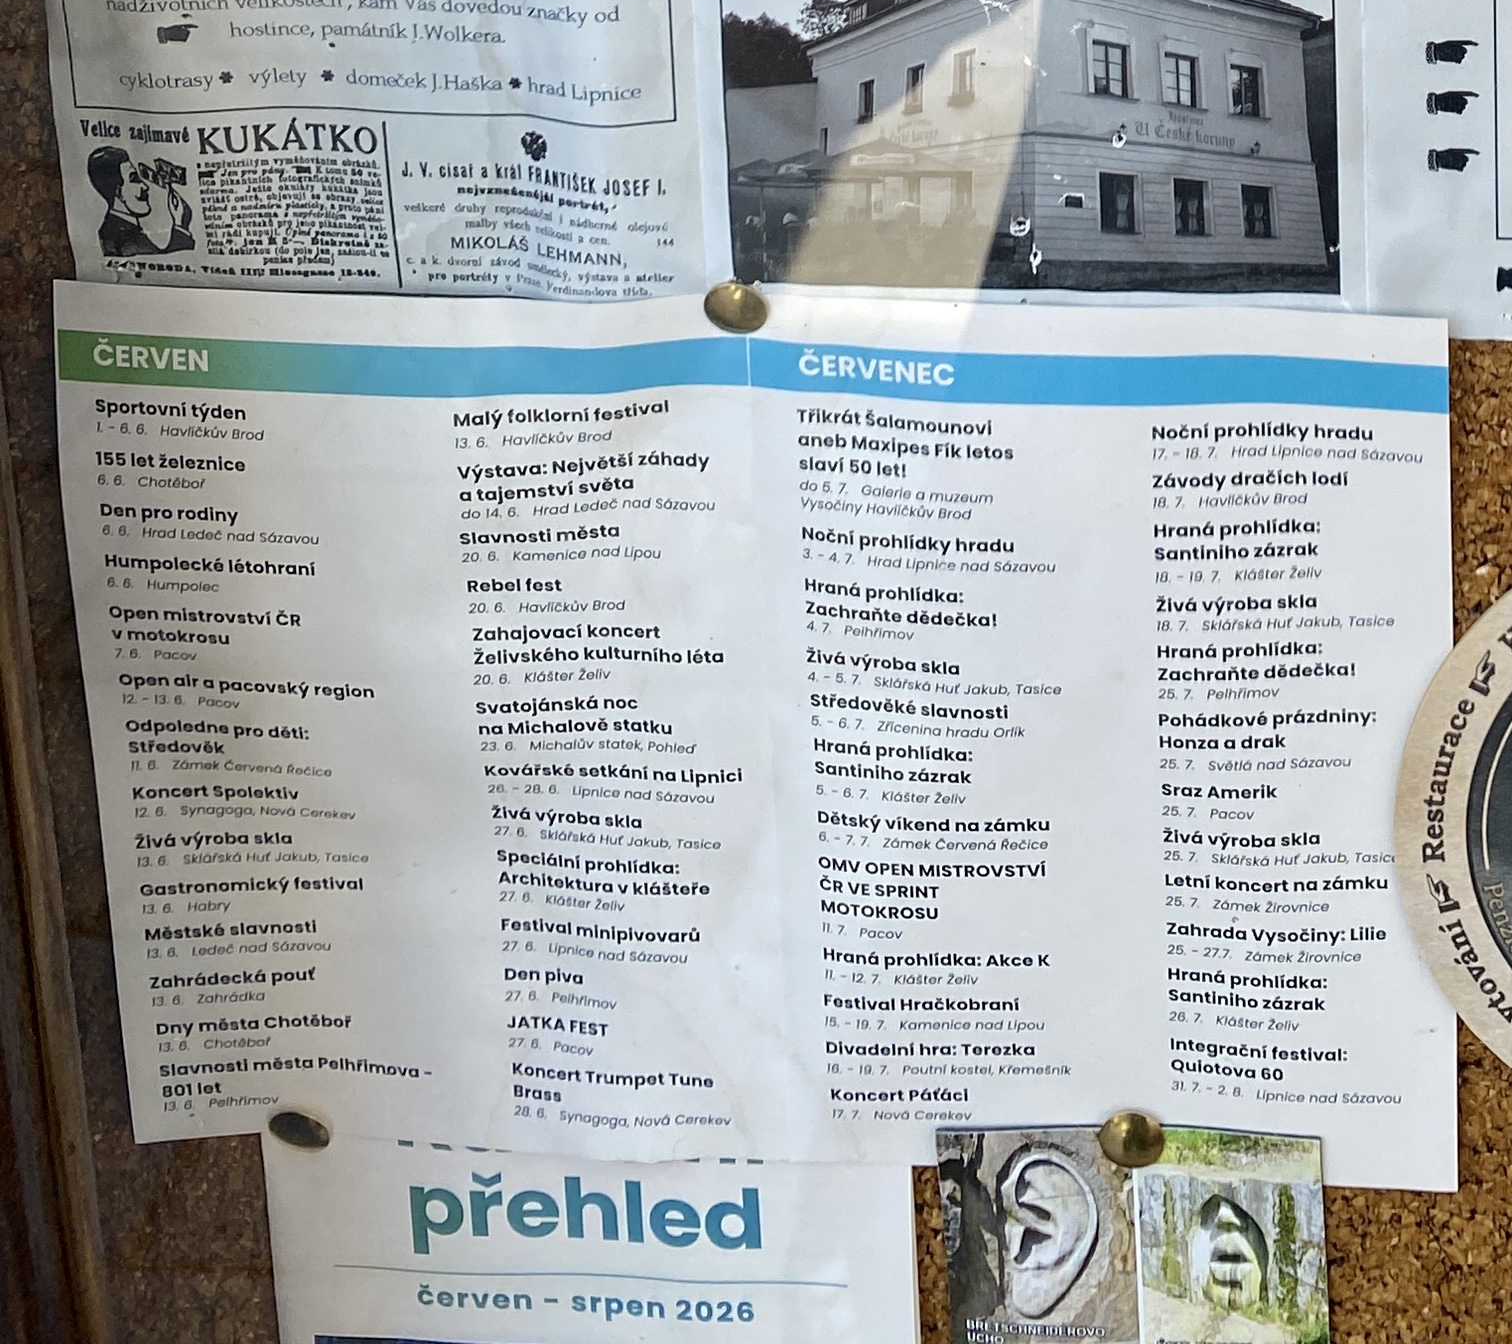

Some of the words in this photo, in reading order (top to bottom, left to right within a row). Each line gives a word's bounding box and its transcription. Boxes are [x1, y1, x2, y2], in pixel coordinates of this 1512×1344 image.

[119, 68, 214, 90] cyklotrasy
[249, 64, 307, 87] výlety
[345, 67, 428, 90] domeček
[527, 76, 566, 98] hrad
[570, 82, 642, 105] Lipnice
[80, 119, 121, 140] Velice
[197, 117, 378, 153] KUKÁTKO
[450, 232, 530, 252] MIKOLÁŠ
[92, 339, 209, 372] ČERVEN
[798, 354, 956, 388] ČERVENEC
[95, 398, 186, 420] Sportovní
[190, 401, 247, 422] týden
[801, 527, 860, 548] Noční
[862, 533, 950, 555] prohlídky
[955, 536, 1016, 554] hradu
[466, 577, 522, 594] Rebel
[526, 576, 563, 593] fest
[1160, 782, 1203, 801] Sraz
[1206, 783, 1278, 800] Amerik
[1422, 696, 1476, 865] Restaurace
[818, 856, 861, 874] OMV
[864, 860, 916, 876] OPEN
[918, 859, 1047, 878] MISTROVSTVÍ
[504, 967, 540, 985] Den
[545, 969, 584, 988] piva
[408, 1171, 763, 1254] přehled
[416, 1284, 532, 1311] červen
[570, 1293, 665, 1321] srpen
[675, 1298, 756, 1324] 2026
